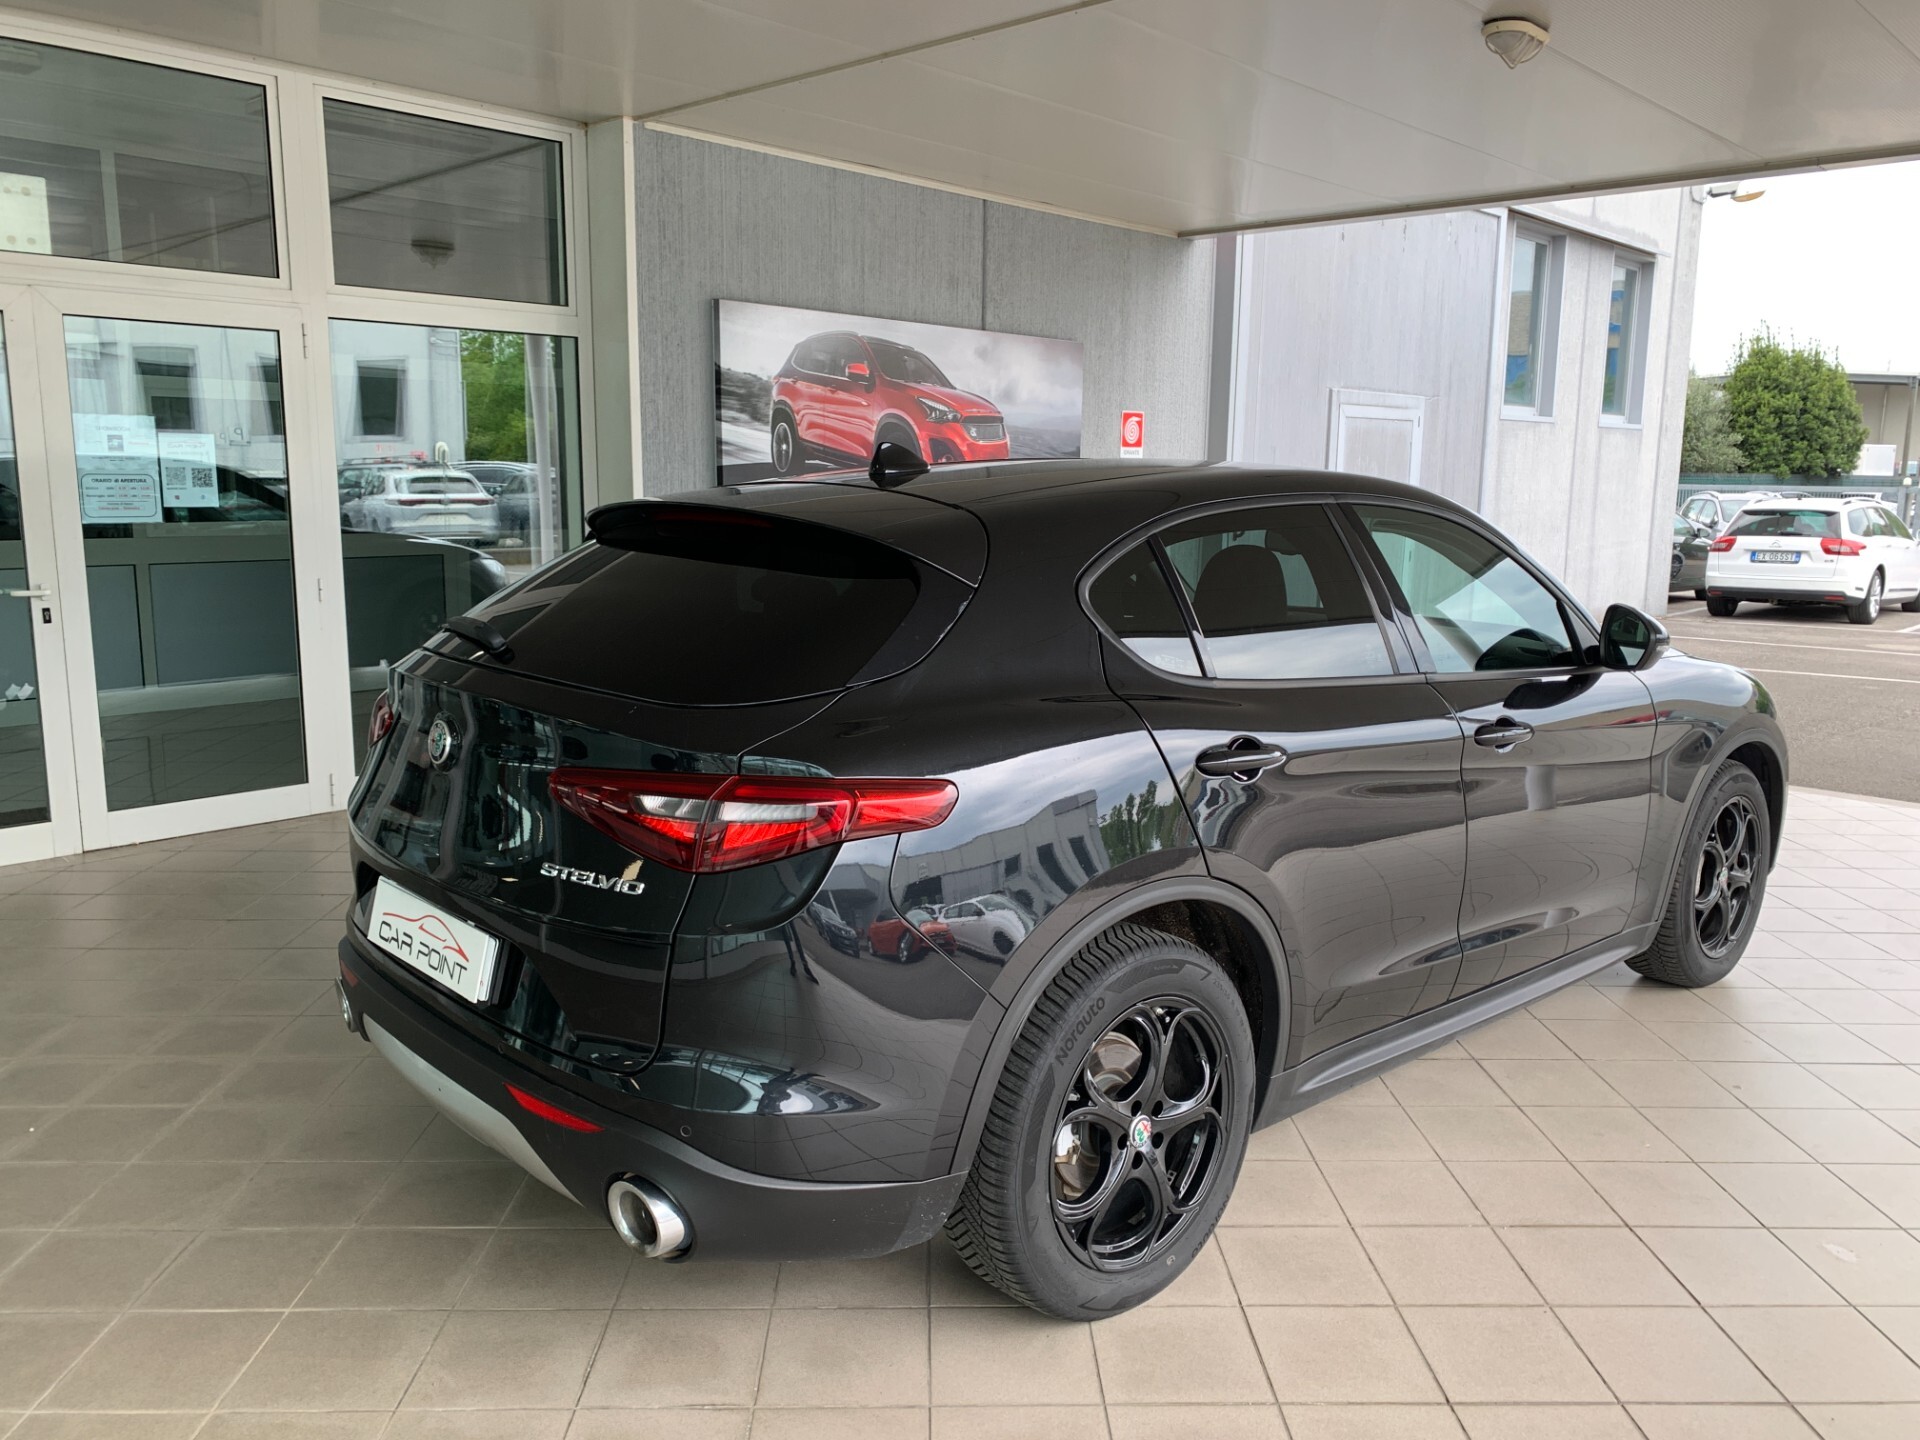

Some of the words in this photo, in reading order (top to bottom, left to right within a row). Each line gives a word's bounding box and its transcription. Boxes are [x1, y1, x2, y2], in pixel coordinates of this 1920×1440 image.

[540, 862, 645, 895] STELVIO
[379, 920, 414, 956] CAR
[416, 941, 468, 985] POINT
